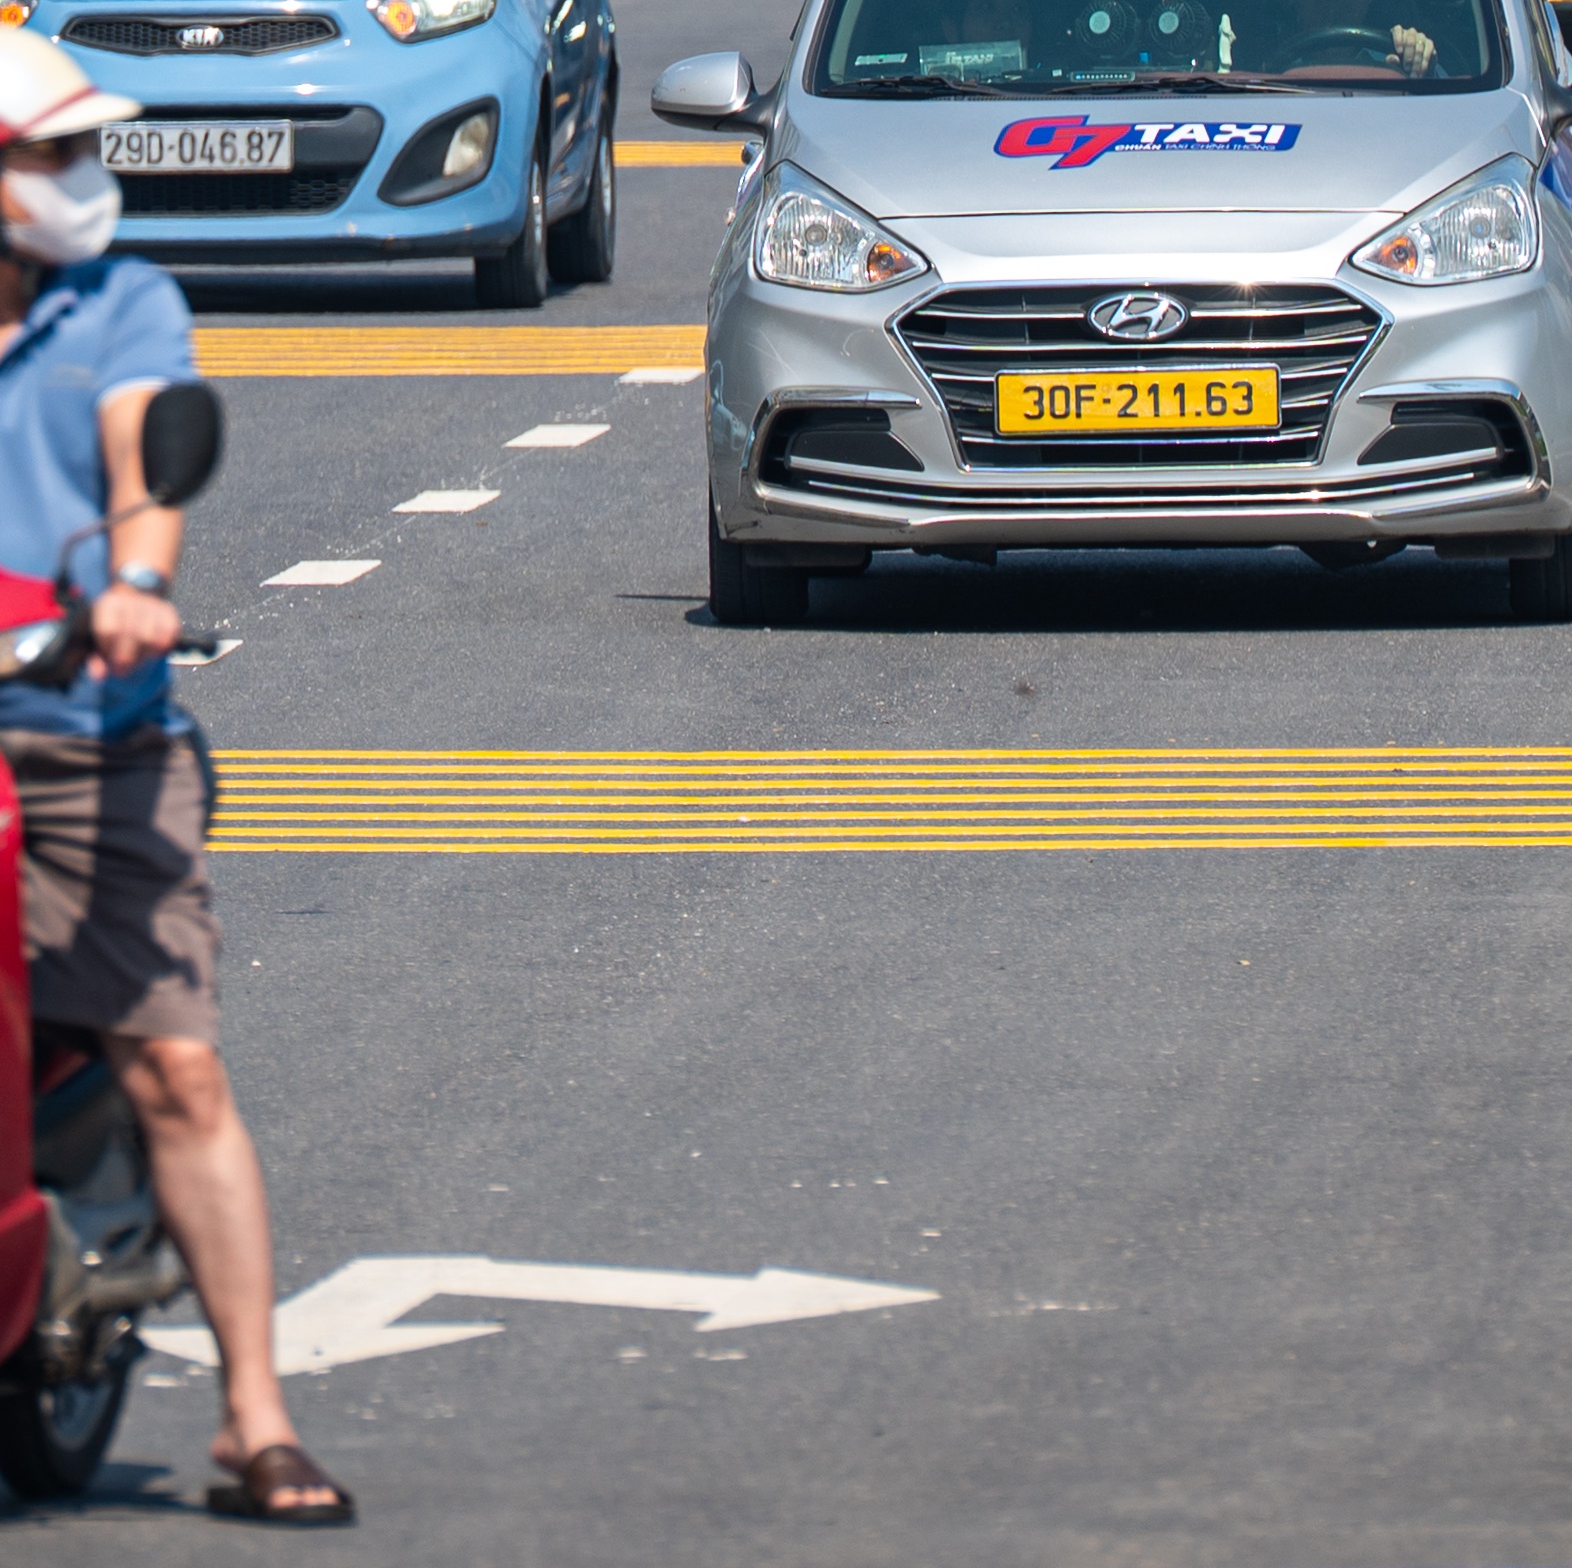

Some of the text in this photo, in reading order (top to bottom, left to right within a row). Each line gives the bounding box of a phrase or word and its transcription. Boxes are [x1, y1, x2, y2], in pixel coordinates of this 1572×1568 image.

[105, 129, 285, 166] 29D-046.87
[996, 116, 1286, 168] G7 TAXI
[1023, 380, 1254, 420] 30F-211.63
